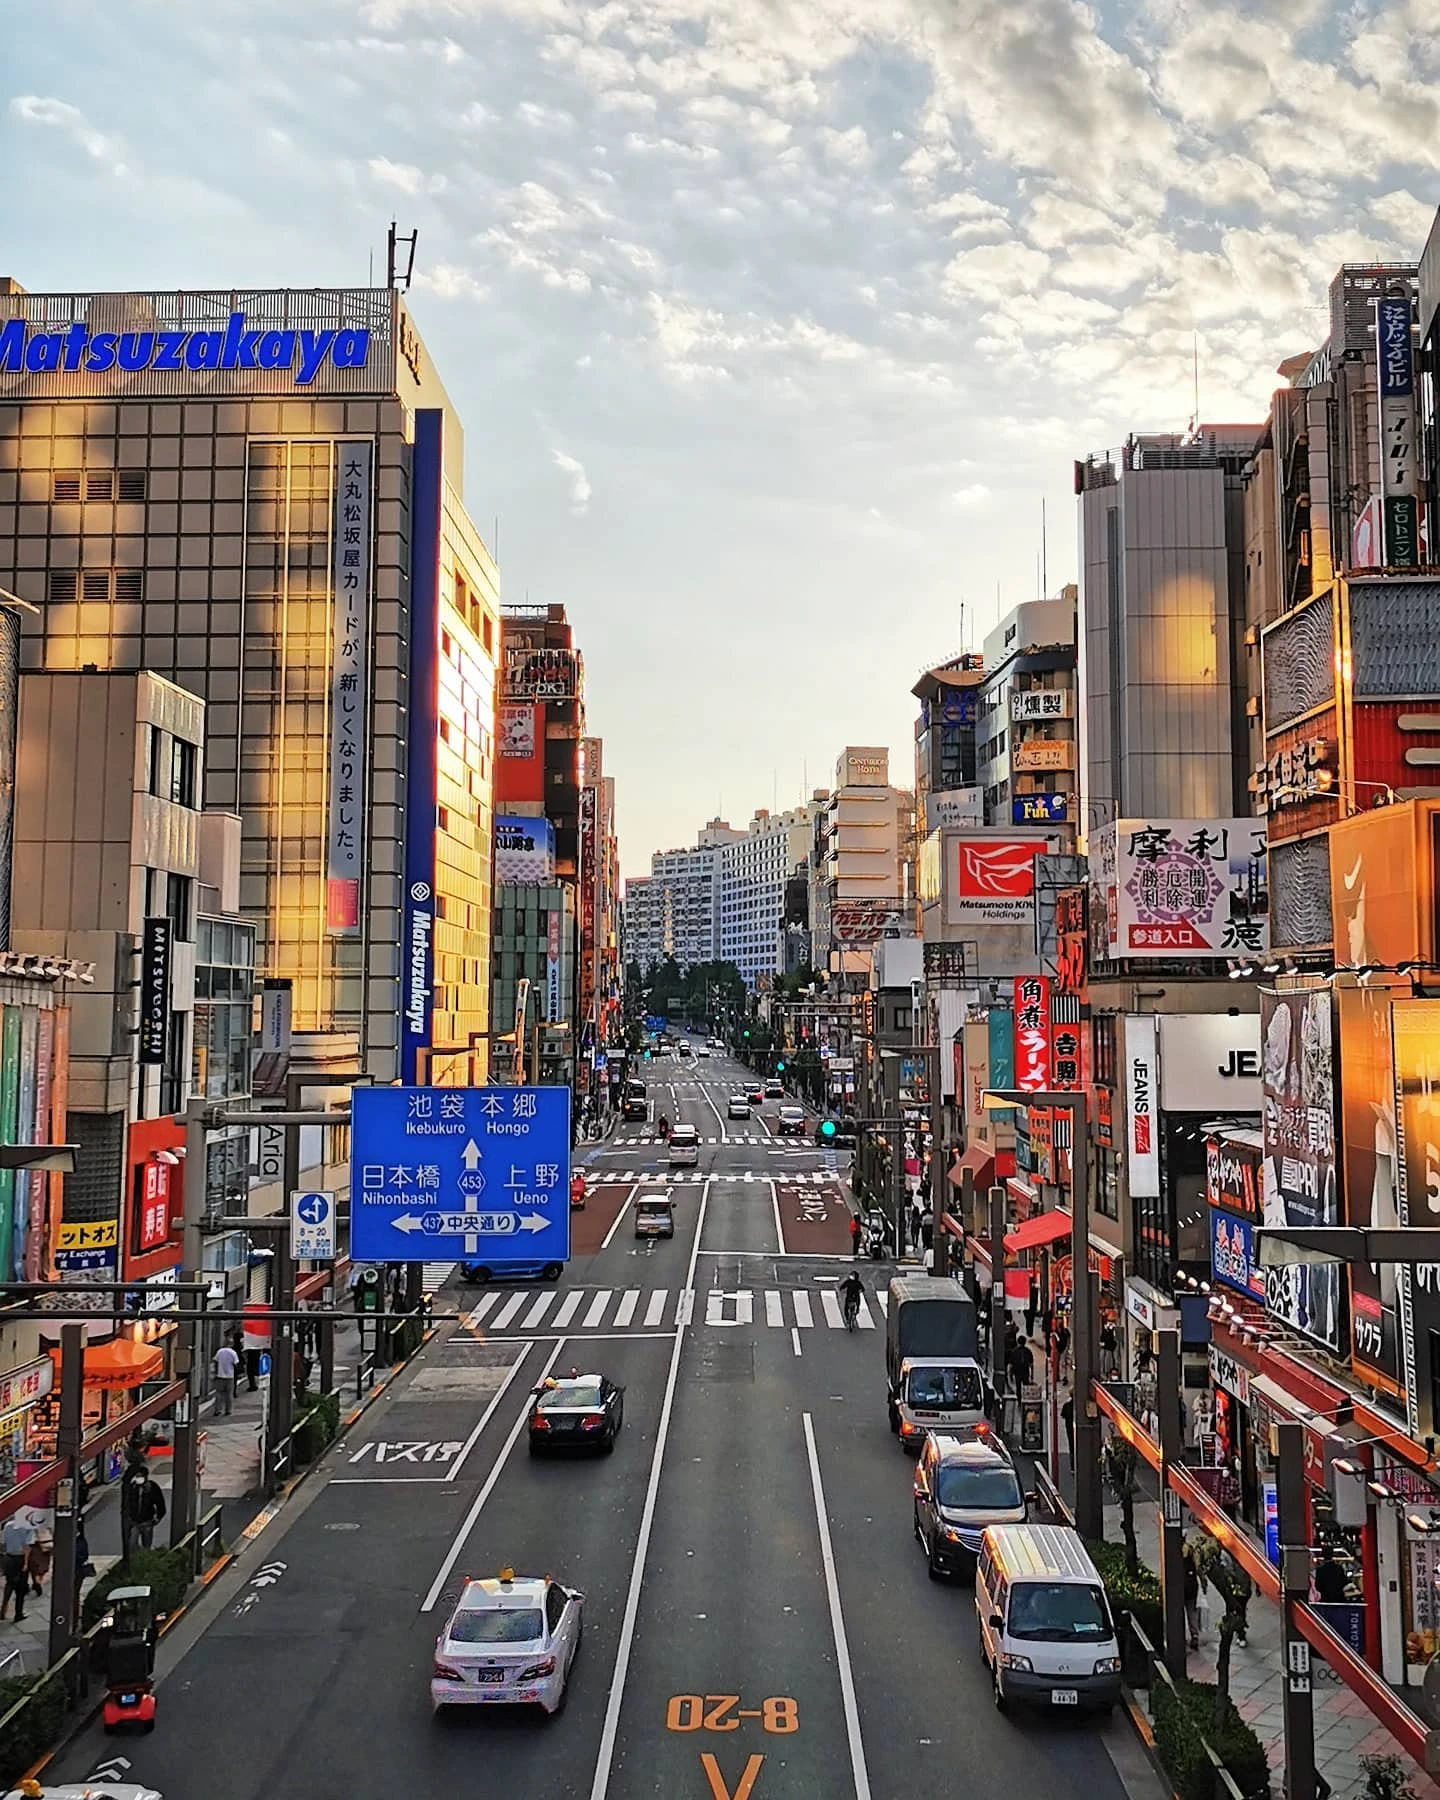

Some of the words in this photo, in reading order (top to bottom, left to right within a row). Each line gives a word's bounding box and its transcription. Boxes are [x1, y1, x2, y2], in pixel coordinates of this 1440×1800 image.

[0, 312, 370, 385] Matsuzakaya
[336, 460, 363, 862] 大丸松坂屋カードが、新しくなりました。
[1142, 869, 1159, 908] 勝利
[1166, 869, 1183, 908] 厄除
[960, 900, 1014, 909] Matsumoto
[982, 909, 1026, 920] Holdings
[1132, 929, 1193, 945] 参道入口
[405, 910, 431, 1034] Matsuzakaya
[1133, 1058, 1149, 1114] JEANS
[408, 1094, 465, 1118] 池袋
[480, 1093, 536, 1118] 本郷
[406, 1121, 466, 1136] Ikebukuro
[486, 1121, 529, 1136] Hongo
[362, 1164, 441, 1190] 日本橋
[503, 1163, 560, 1189] 上野
[461, 1175, 482, 1190] 453
[362, 1191, 437, 1206] Nihonbashi
[513, 1191, 549, 1205] Ueno
[423, 1216, 442, 1229] 437
[447, 1215, 512, 1232] 中央通り
[1355, 1315, 1383, 1358] サクラ
[347, 1440, 465, 1464] バス停
[665, 1693, 800, 1734] 8-20
